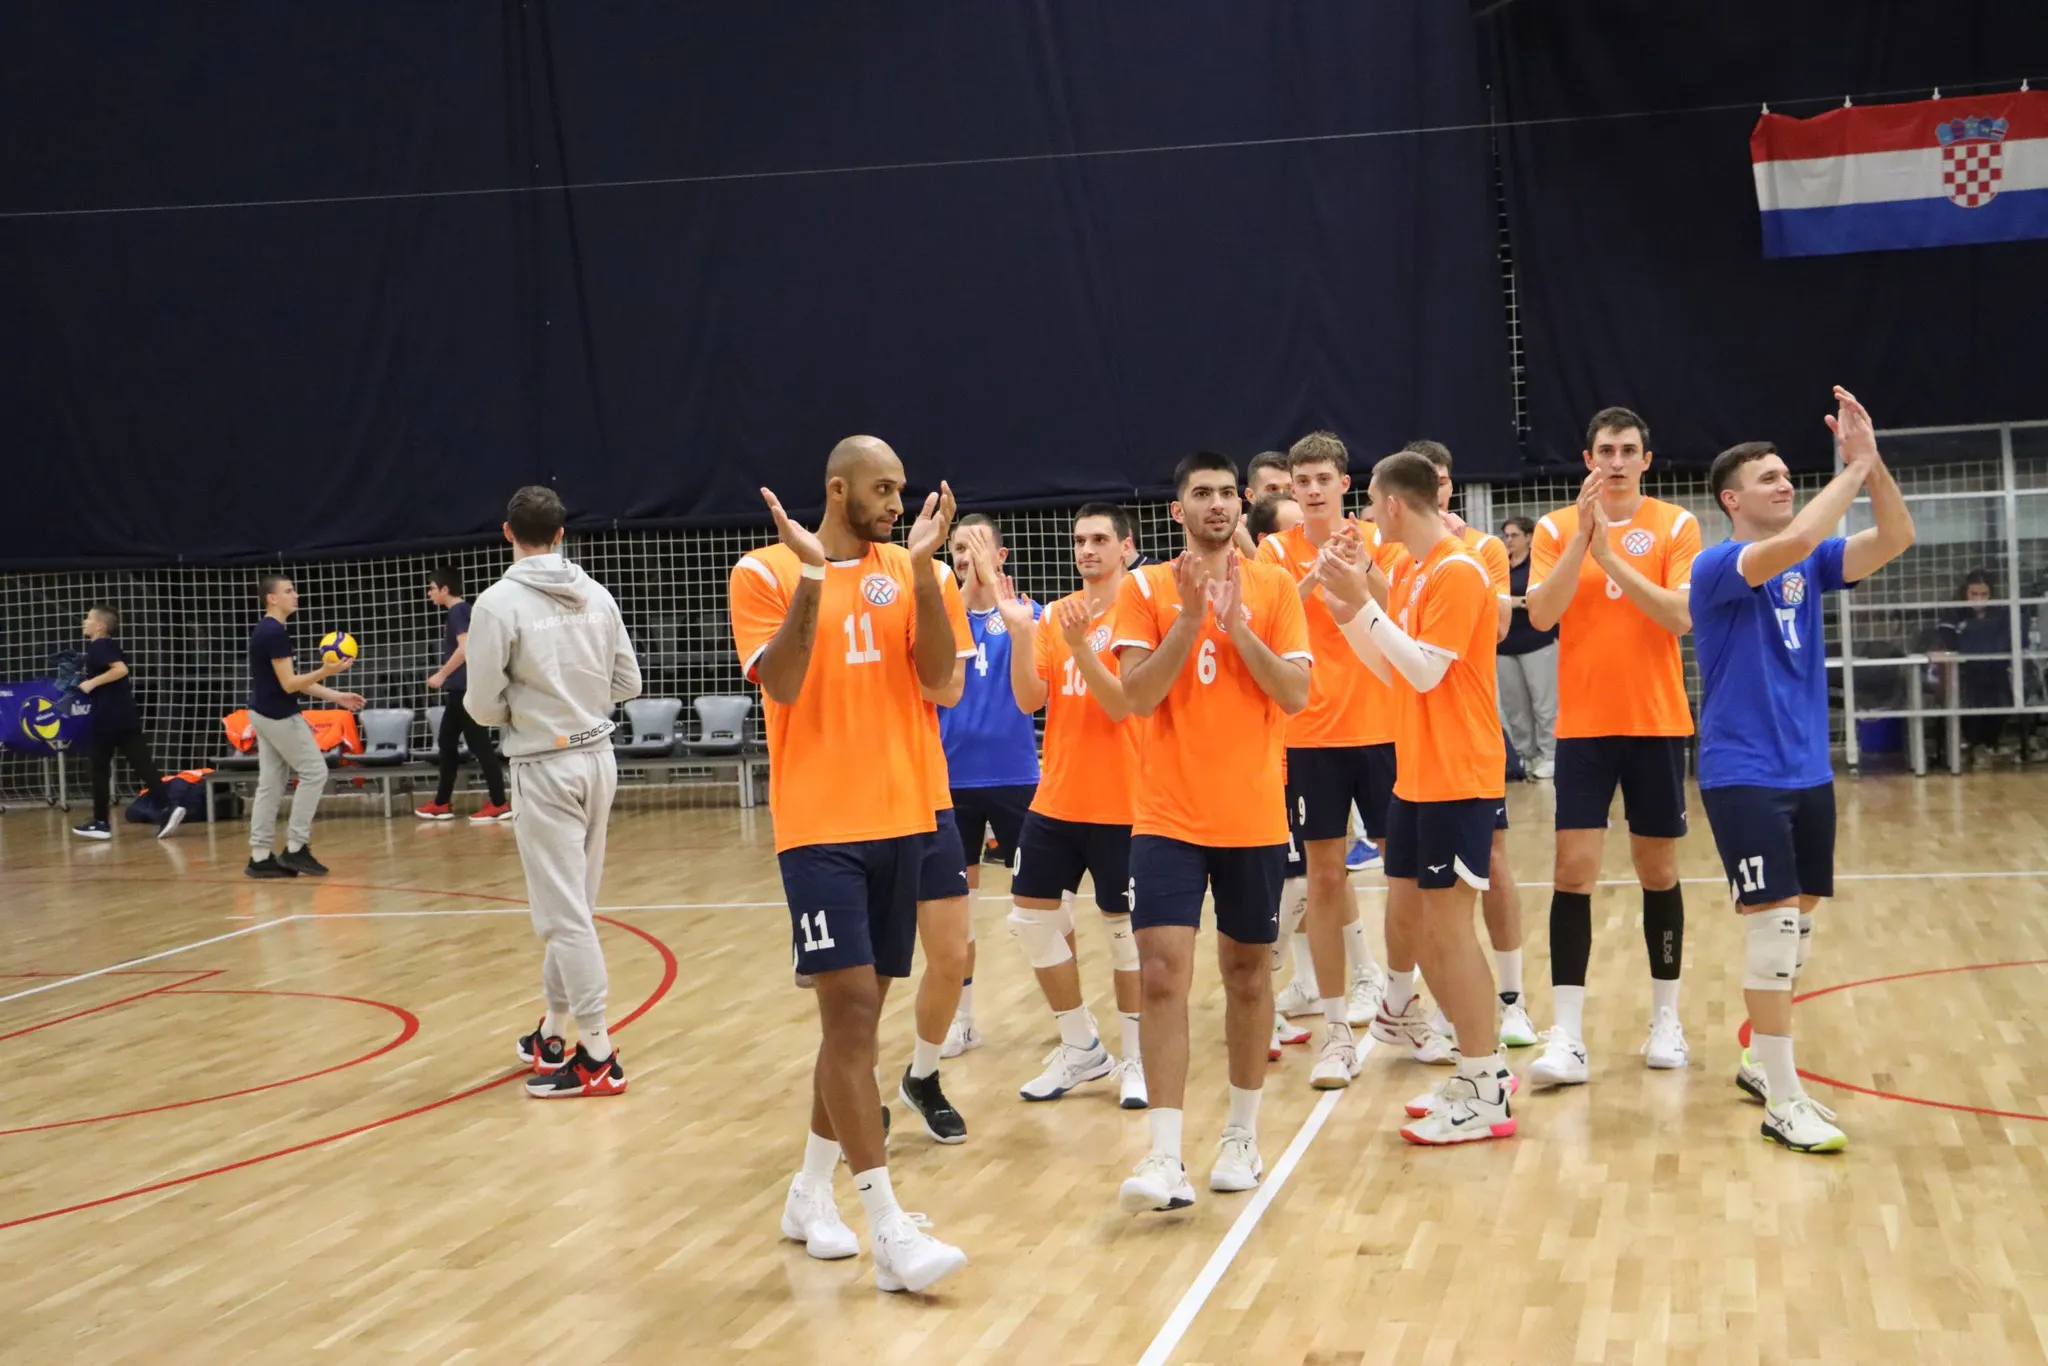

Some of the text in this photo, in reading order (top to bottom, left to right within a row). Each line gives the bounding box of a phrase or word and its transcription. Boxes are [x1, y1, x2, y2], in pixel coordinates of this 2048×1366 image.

[844, 612, 881, 665] 11
[974, 642, 989, 677] 4
[1197, 638, 1217, 685] 6
[1298, 795, 1306, 826] 9
[1738, 855, 1766, 893] 17
[1128, 876, 1136, 912] 6
[800, 909, 836, 952] 11
